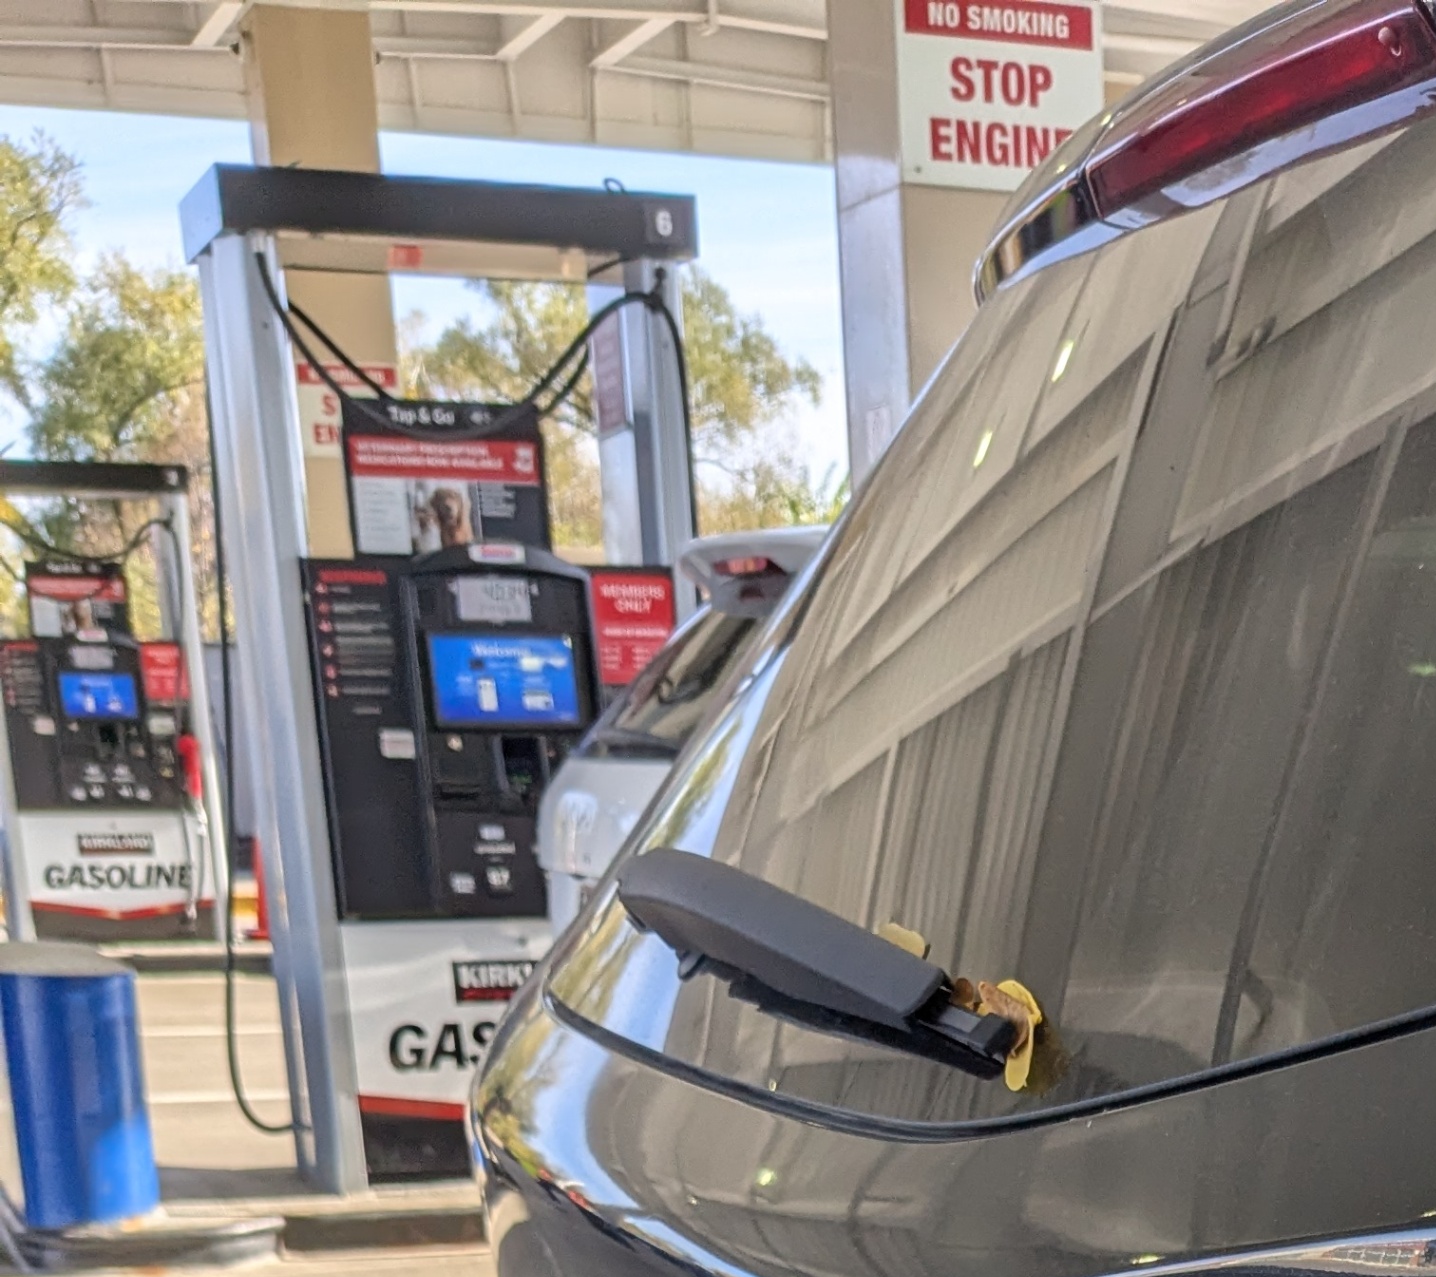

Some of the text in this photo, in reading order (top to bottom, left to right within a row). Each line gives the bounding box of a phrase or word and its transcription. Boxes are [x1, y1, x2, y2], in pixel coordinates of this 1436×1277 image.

[926, 2, 1070, 39] NO SMOKING
[949, 56, 1054, 108] STOP
[656, 210, 673, 237] 6
[45, 864, 193, 890] GASOLINE
